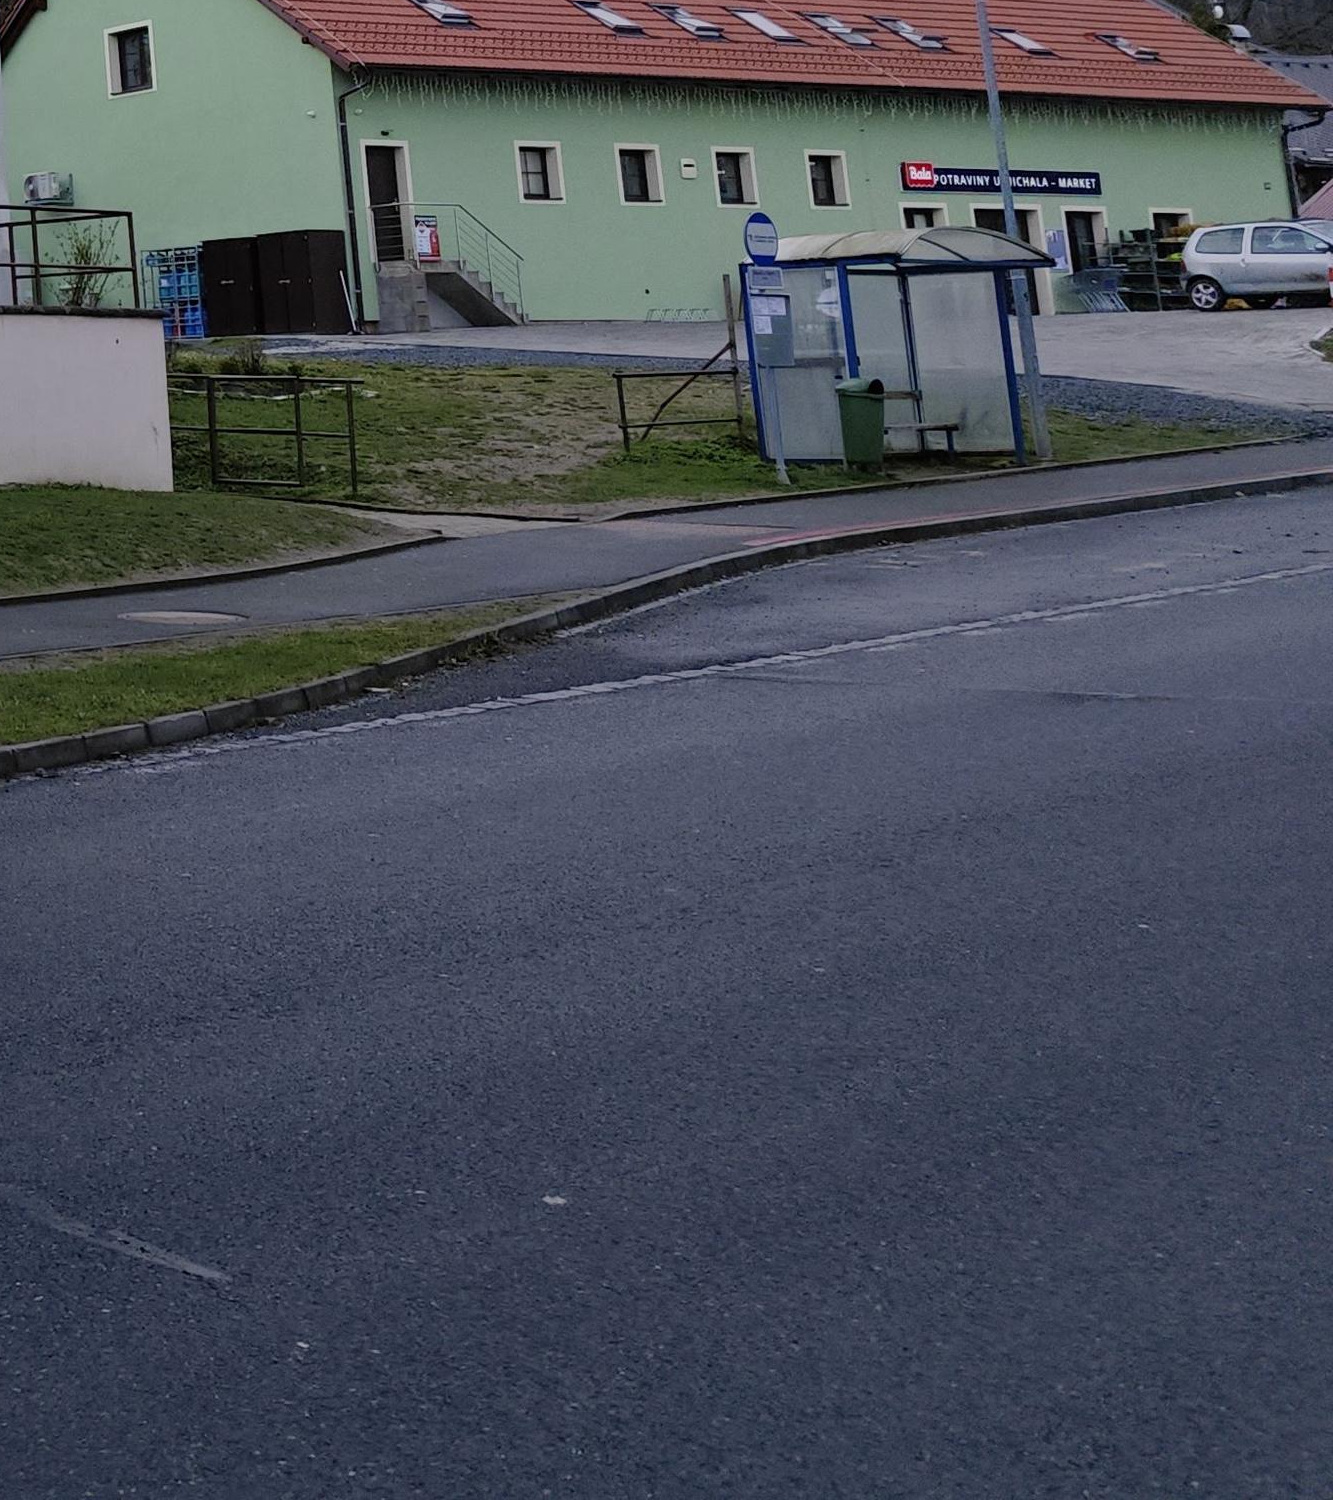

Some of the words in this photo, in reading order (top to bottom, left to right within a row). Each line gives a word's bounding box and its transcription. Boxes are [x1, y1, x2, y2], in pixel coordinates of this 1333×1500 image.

[909, 166, 933, 181] Bala
[934, 174, 990, 186] POTRAVINY
[993, 175, 1001, 186] U
[1058, 177, 1096, 189] MARKET
